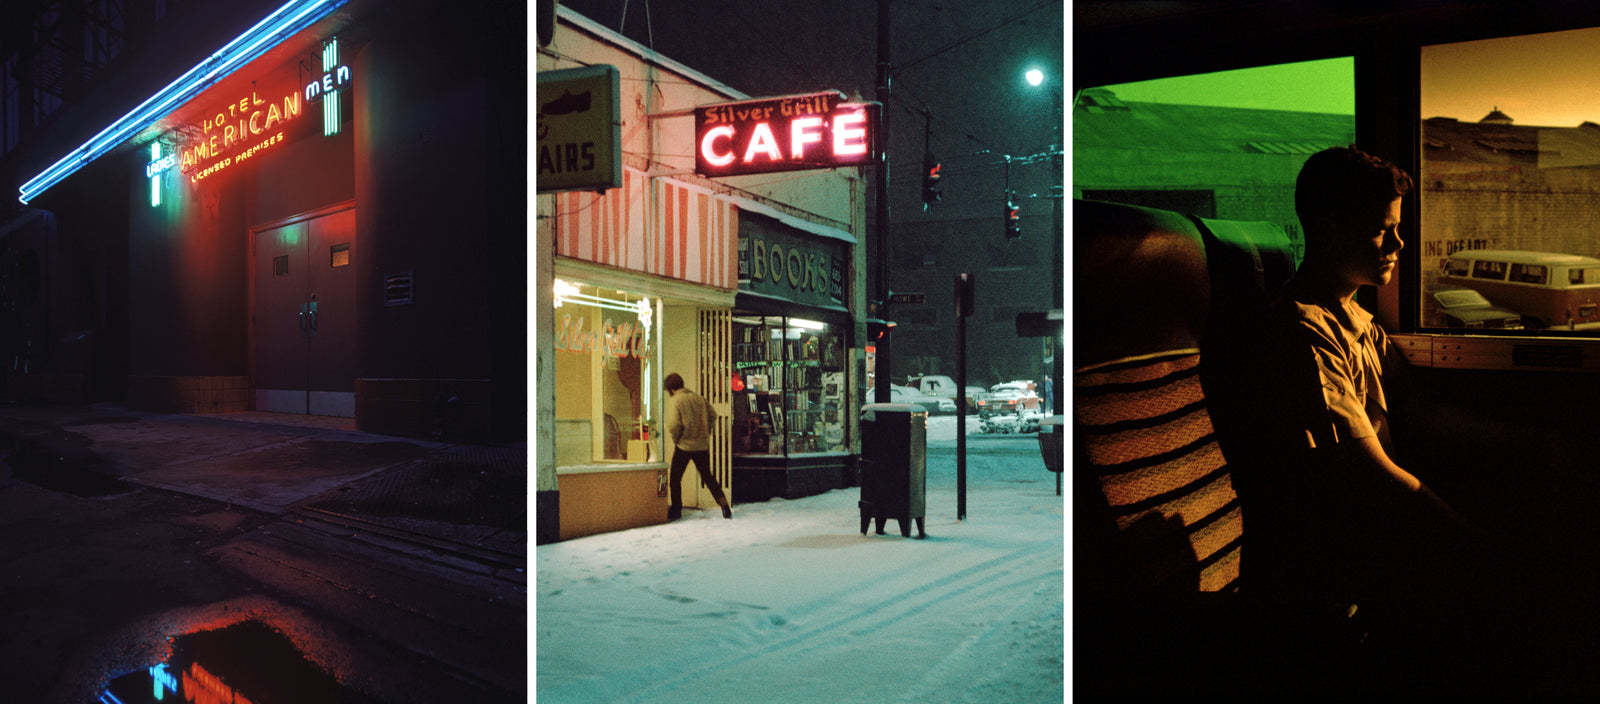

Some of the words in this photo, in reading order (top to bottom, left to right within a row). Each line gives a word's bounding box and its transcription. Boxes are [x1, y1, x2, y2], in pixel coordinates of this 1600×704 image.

[181, 91, 300, 171] AMERICAN
[203, 92, 263, 134] HOTEL
[704, 105, 774, 125] Silver
[780, 96, 830, 116] Grill
[146, 153, 176, 178] LADIES
[191, 157, 231, 183] LICENSED
[235, 132, 284, 164] PREMISES
[753, 238, 828, 293] BOOKS
[555, 313, 598, 353] Silver
[600, 318, 632, 369] Grill
